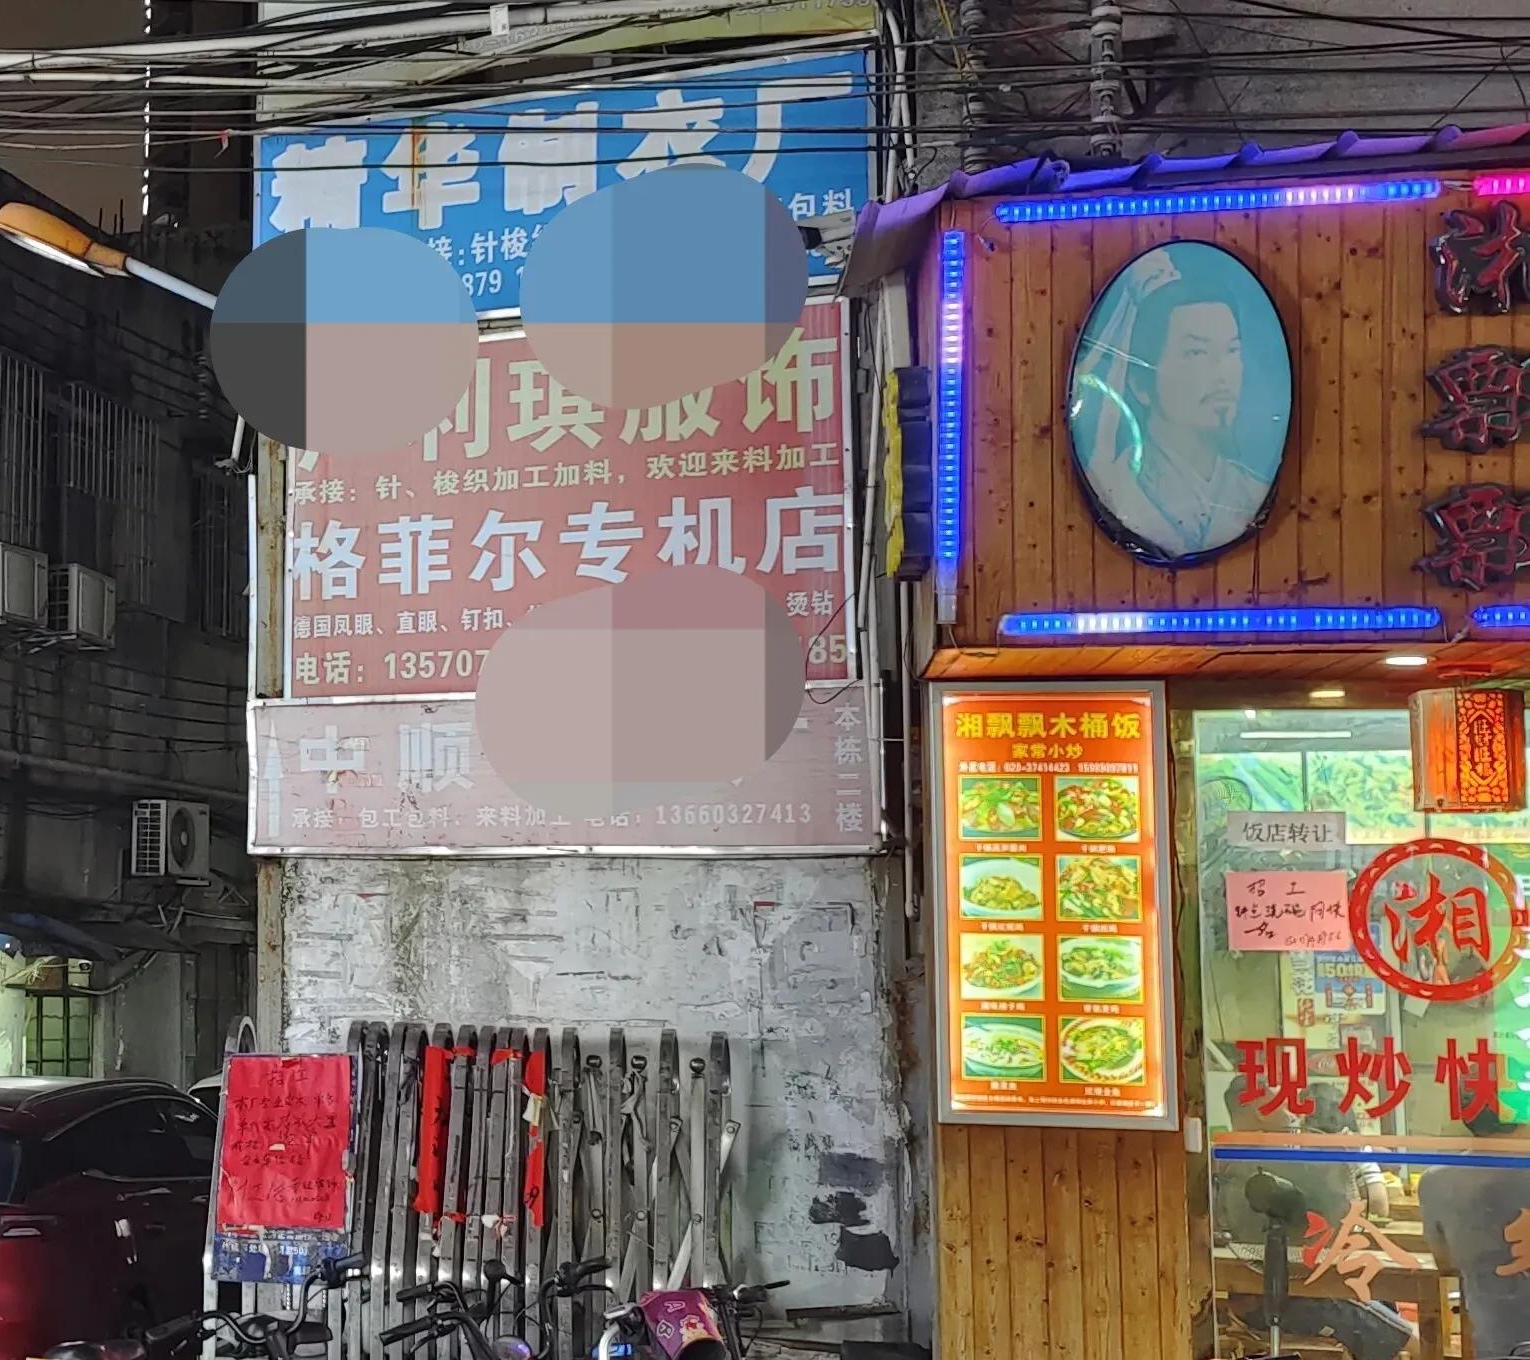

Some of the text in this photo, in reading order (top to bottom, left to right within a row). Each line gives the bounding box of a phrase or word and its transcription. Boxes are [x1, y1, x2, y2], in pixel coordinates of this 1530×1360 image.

[293, 485, 844, 601] 格菲尔专机店
[786, 589, 834, 617] 烫钻
[799, 635, 847, 664] 85
[955, 712, 1141, 739] 湘飘飘木桶饭
[1242, 821, 1334, 844] 饭店转让
[1382, 872, 1491, 965] 湘
